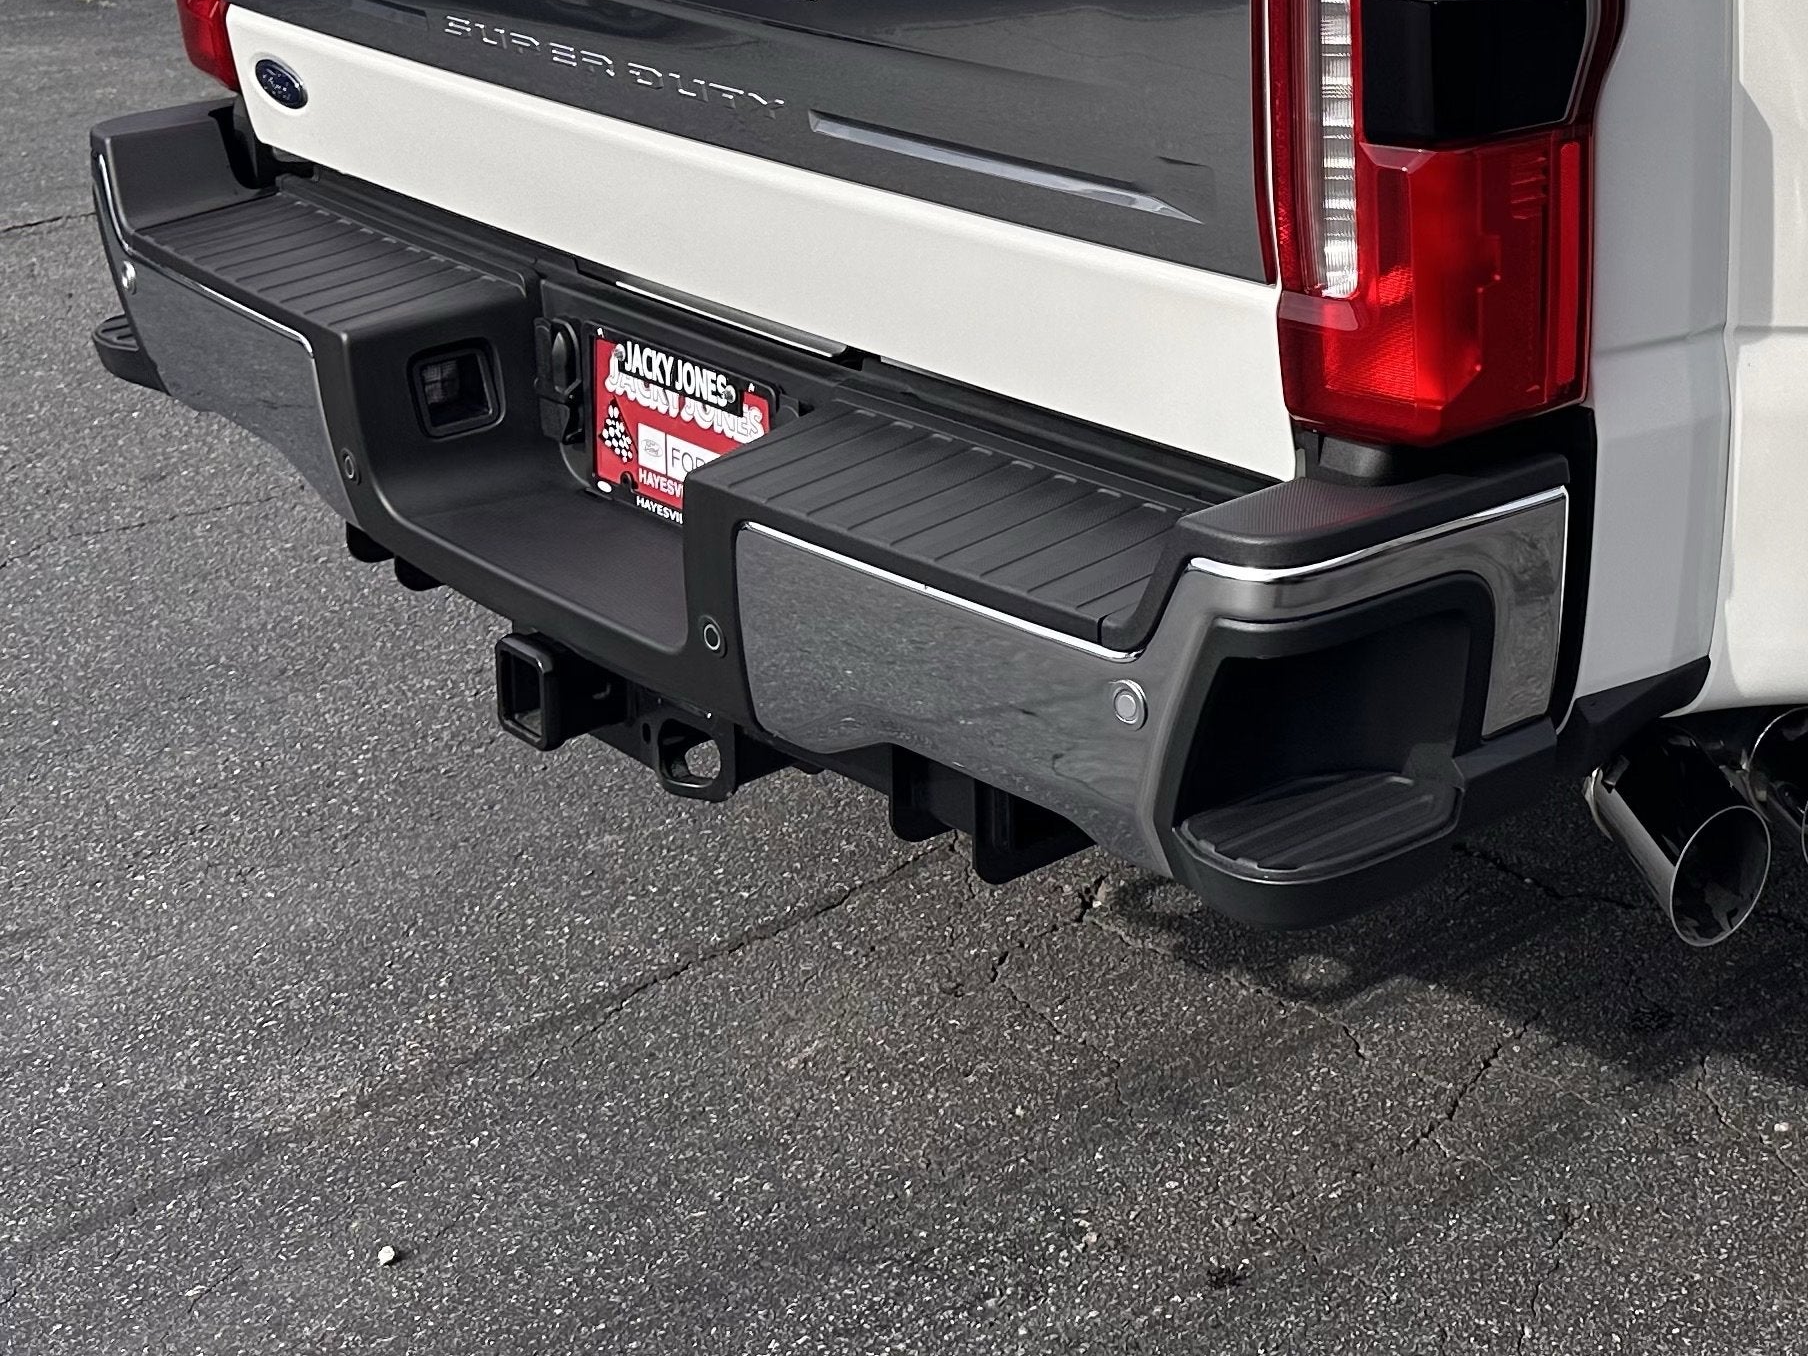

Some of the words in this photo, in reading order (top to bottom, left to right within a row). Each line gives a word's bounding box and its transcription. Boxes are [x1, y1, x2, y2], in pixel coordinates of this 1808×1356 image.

[444, 14, 615, 77] SUPER
[628, 61, 786, 119] DUTY
[624, 341, 675, 387] JACKY
[674, 358, 728, 407] JONES
